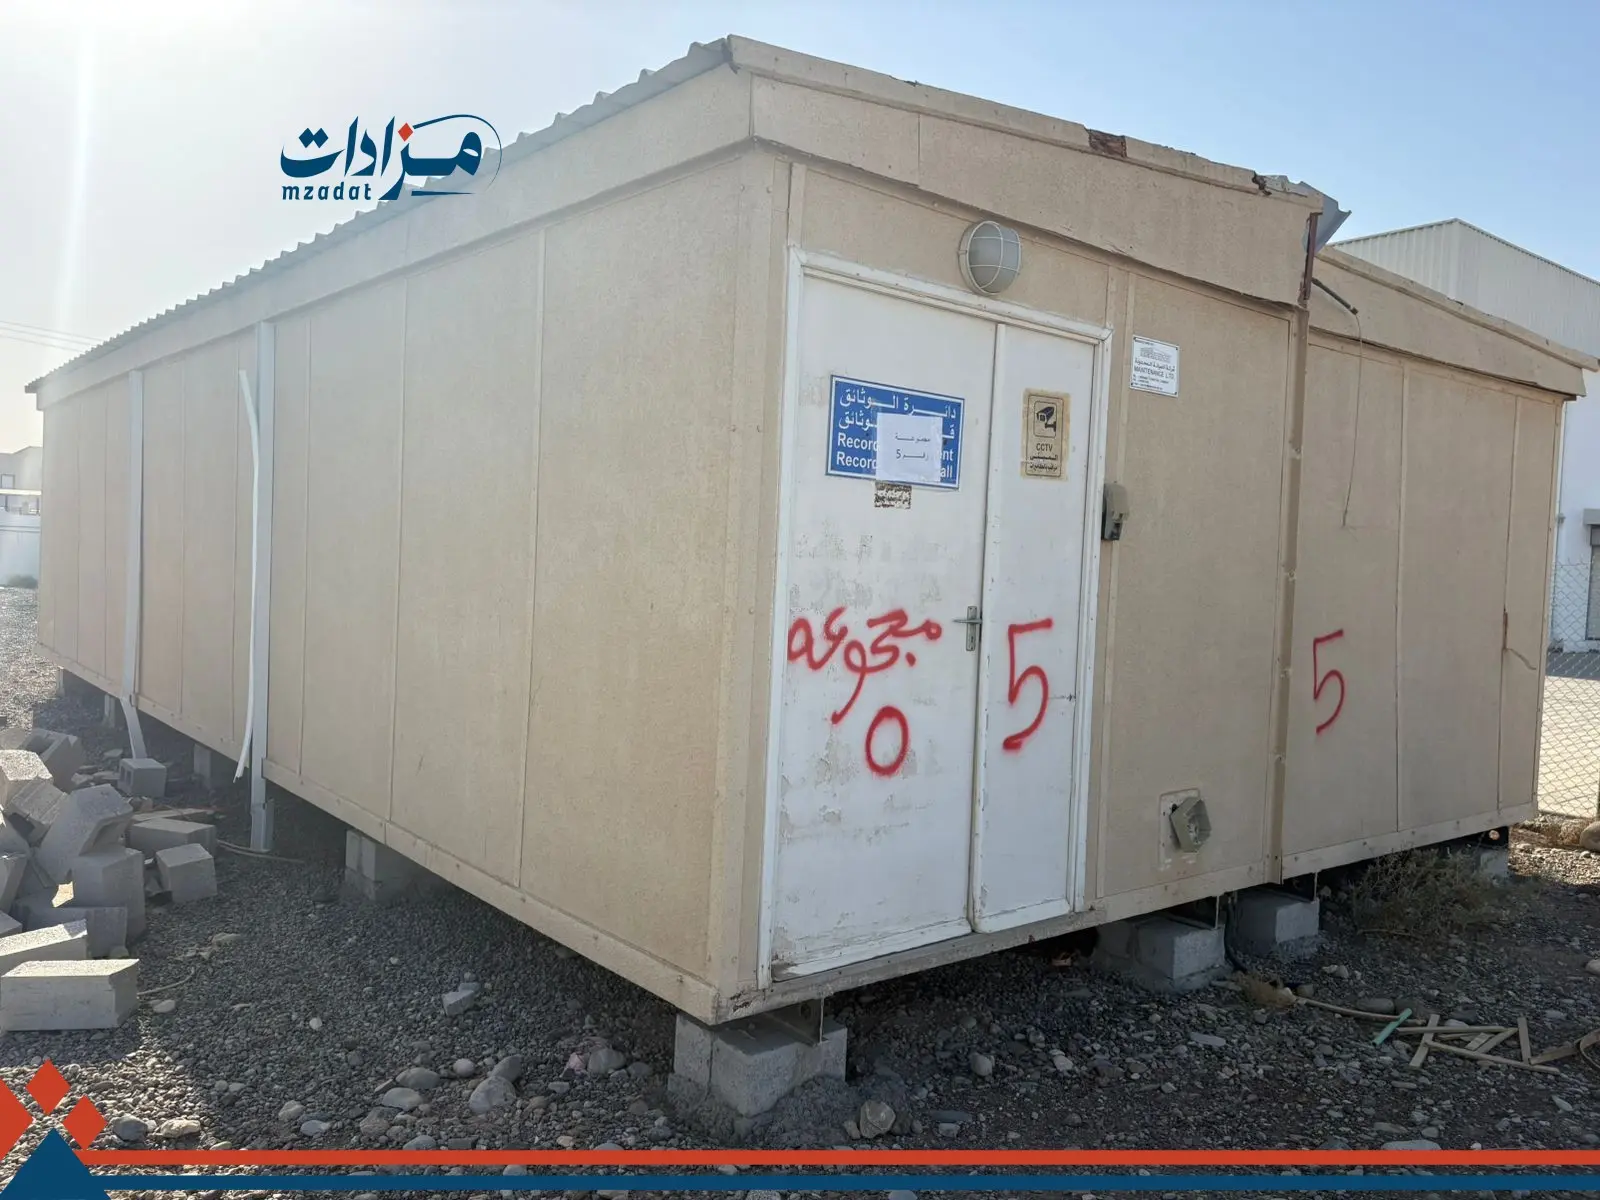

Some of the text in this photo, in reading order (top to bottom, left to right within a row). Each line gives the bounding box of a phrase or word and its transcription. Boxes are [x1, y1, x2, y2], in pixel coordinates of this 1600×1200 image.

[839, 387, 899, 410] الوثائق
[895, 448, 902, 460] 5
[1036, 443, 1053, 452] CCTV
[940, 465, 953, 478] all
[1002, 616, 1054, 752] 5
[1312, 628, 1345, 736] 5
